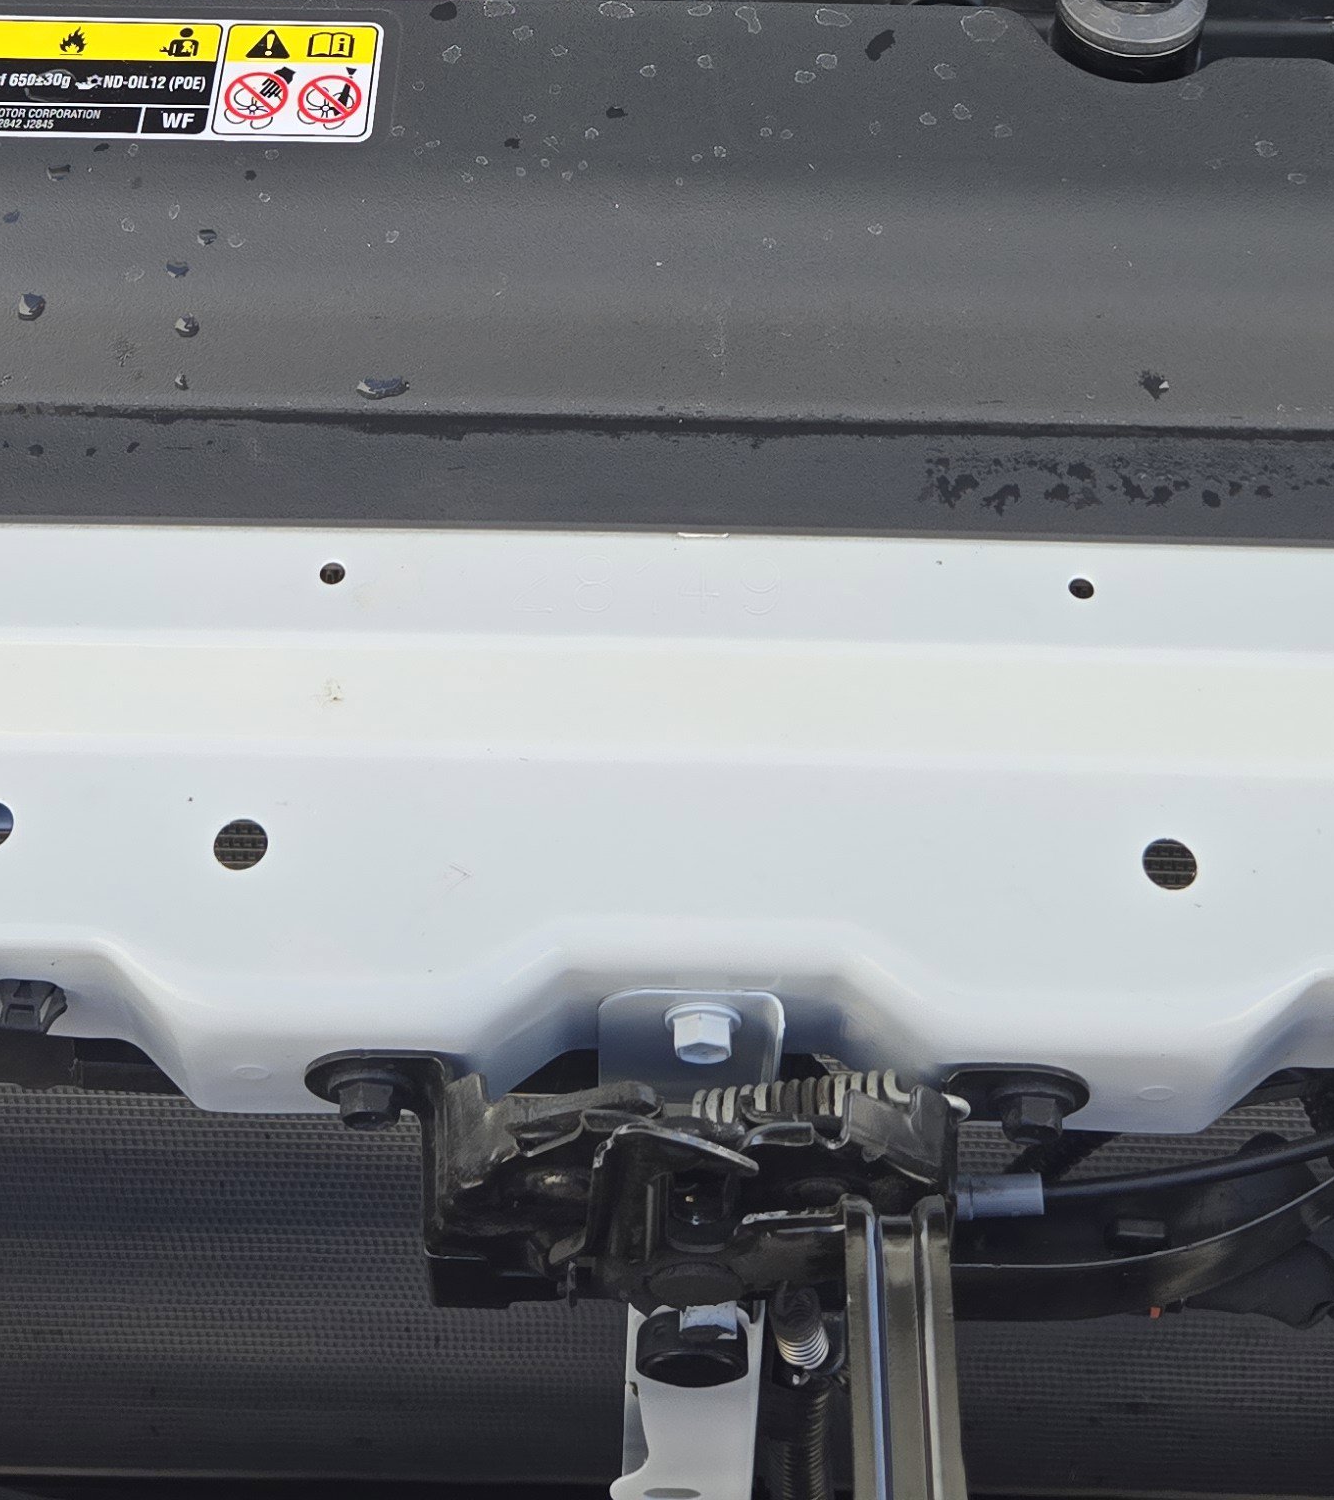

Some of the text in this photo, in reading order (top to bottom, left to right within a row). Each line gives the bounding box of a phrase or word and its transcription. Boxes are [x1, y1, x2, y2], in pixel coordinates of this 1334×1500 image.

[8, 73, 72, 89] 650±30g
[102, 75, 167, 90] ND-OIL12
[168, 75, 206, 92] (POE)
[28, 108, 101, 119] CORPORATION
[23, 119, 54, 129] J2845
[161, 113, 196, 129] WF
